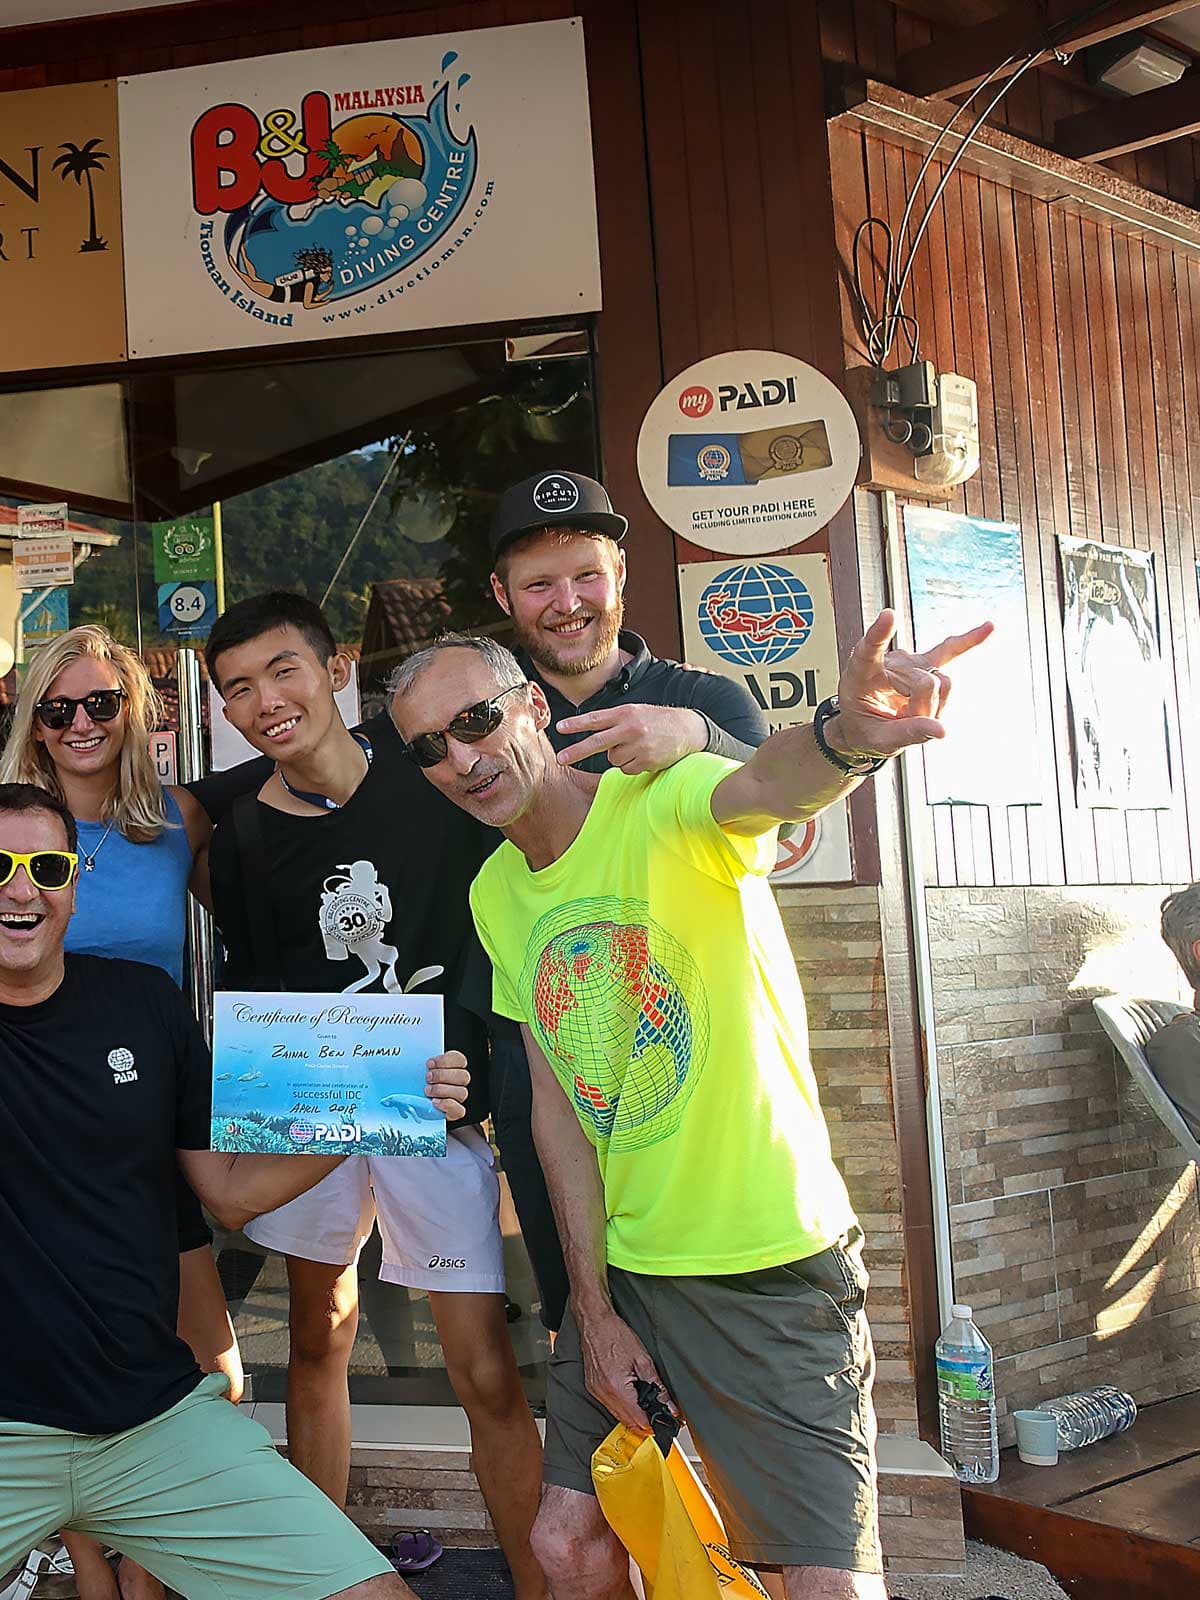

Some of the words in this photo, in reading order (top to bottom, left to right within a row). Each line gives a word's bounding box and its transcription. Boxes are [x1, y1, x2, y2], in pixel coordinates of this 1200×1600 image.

[334, 85, 426, 111] MALAYSIA
[191, 91, 333, 215] B&J
[340, 235, 416, 284] DIVING
[417, 151, 465, 233] CENTRE
[199, 220, 230, 295] Tioman
[229, 289, 294, 327] Island
[682, 393, 708, 413] my
[718, 377, 796, 411] PADI
[692, 510, 714, 521] GET
[716, 505, 749, 518] YOUR
[753, 502, 780, 514] PADI
[783, 498, 816, 511] HERE
[692, 519, 731, 530] INCLUDING
[732, 516, 761, 525] LIMITED
[763, 513, 792, 522] EDITION
[793, 510, 817, 519] CARDS
[175, 597, 201, 611] 8.4
[339, 912, 367, 931] 30
[232, 1002, 307, 1029] Certificate
[309, 1008, 327, 1030] of
[328, 1005, 423, 1032] Recognition
[319, 1045, 345, 1058] BEN
[353, 1044, 401, 1057] RAHMAN
[113, 1070, 138, 1084] PADI
[293, 1090, 341, 1100] successful
[346, 1090, 361, 1100] IDC
[329, 1103, 357, 1114] 2018
[315, 1123, 361, 1142] PADI
[440, 1258, 466, 1268] asics
